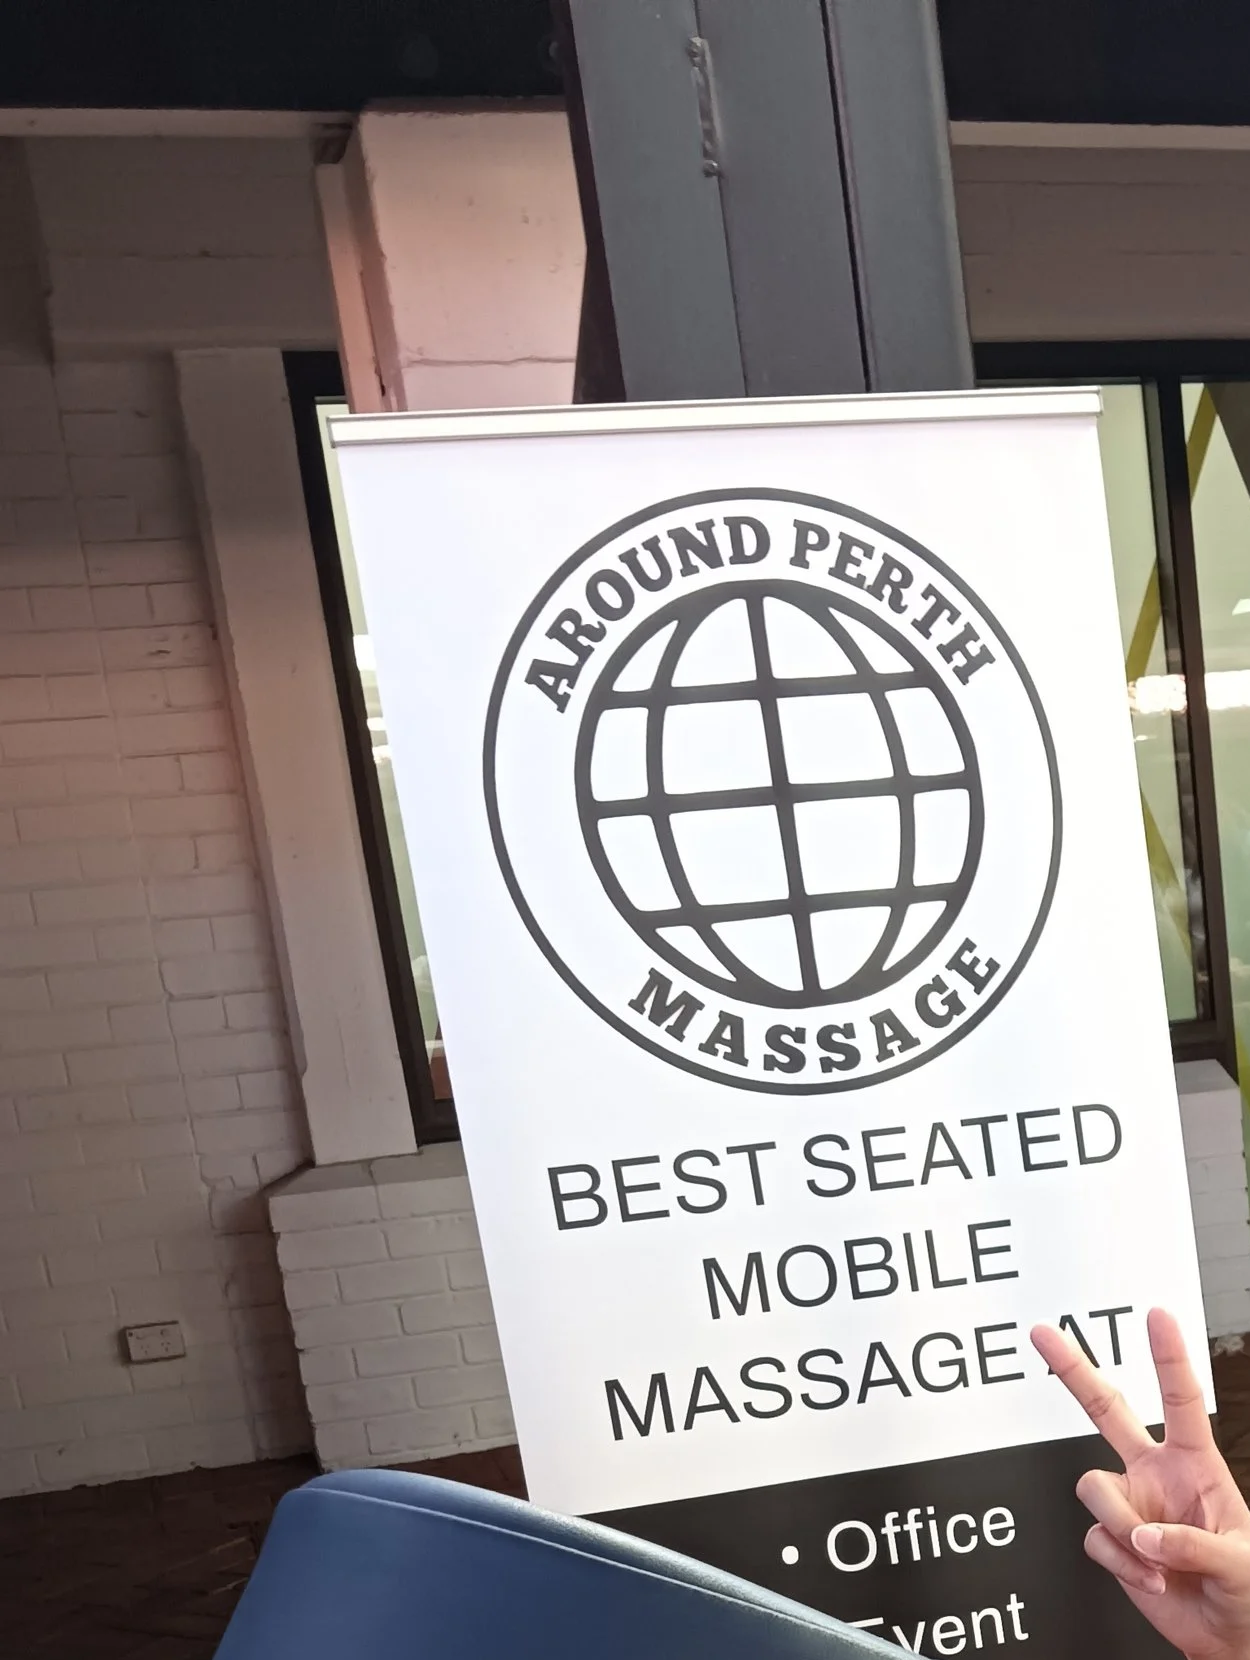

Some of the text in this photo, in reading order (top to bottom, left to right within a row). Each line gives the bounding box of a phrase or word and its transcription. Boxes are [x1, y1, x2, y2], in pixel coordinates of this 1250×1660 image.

[525, 516, 996, 713] AROUND PERTH
[628, 938, 1000, 1074] MASSAGE
[548, 1103, 1123, 1231] BEST SEATED
[702, 1219, 1019, 1320] MOBILE
[604, 1321, 1026, 1441] MASSAGE
[826, 1506, 1016, 1572] Office
[846, 1593, 1029, 1655] vent
